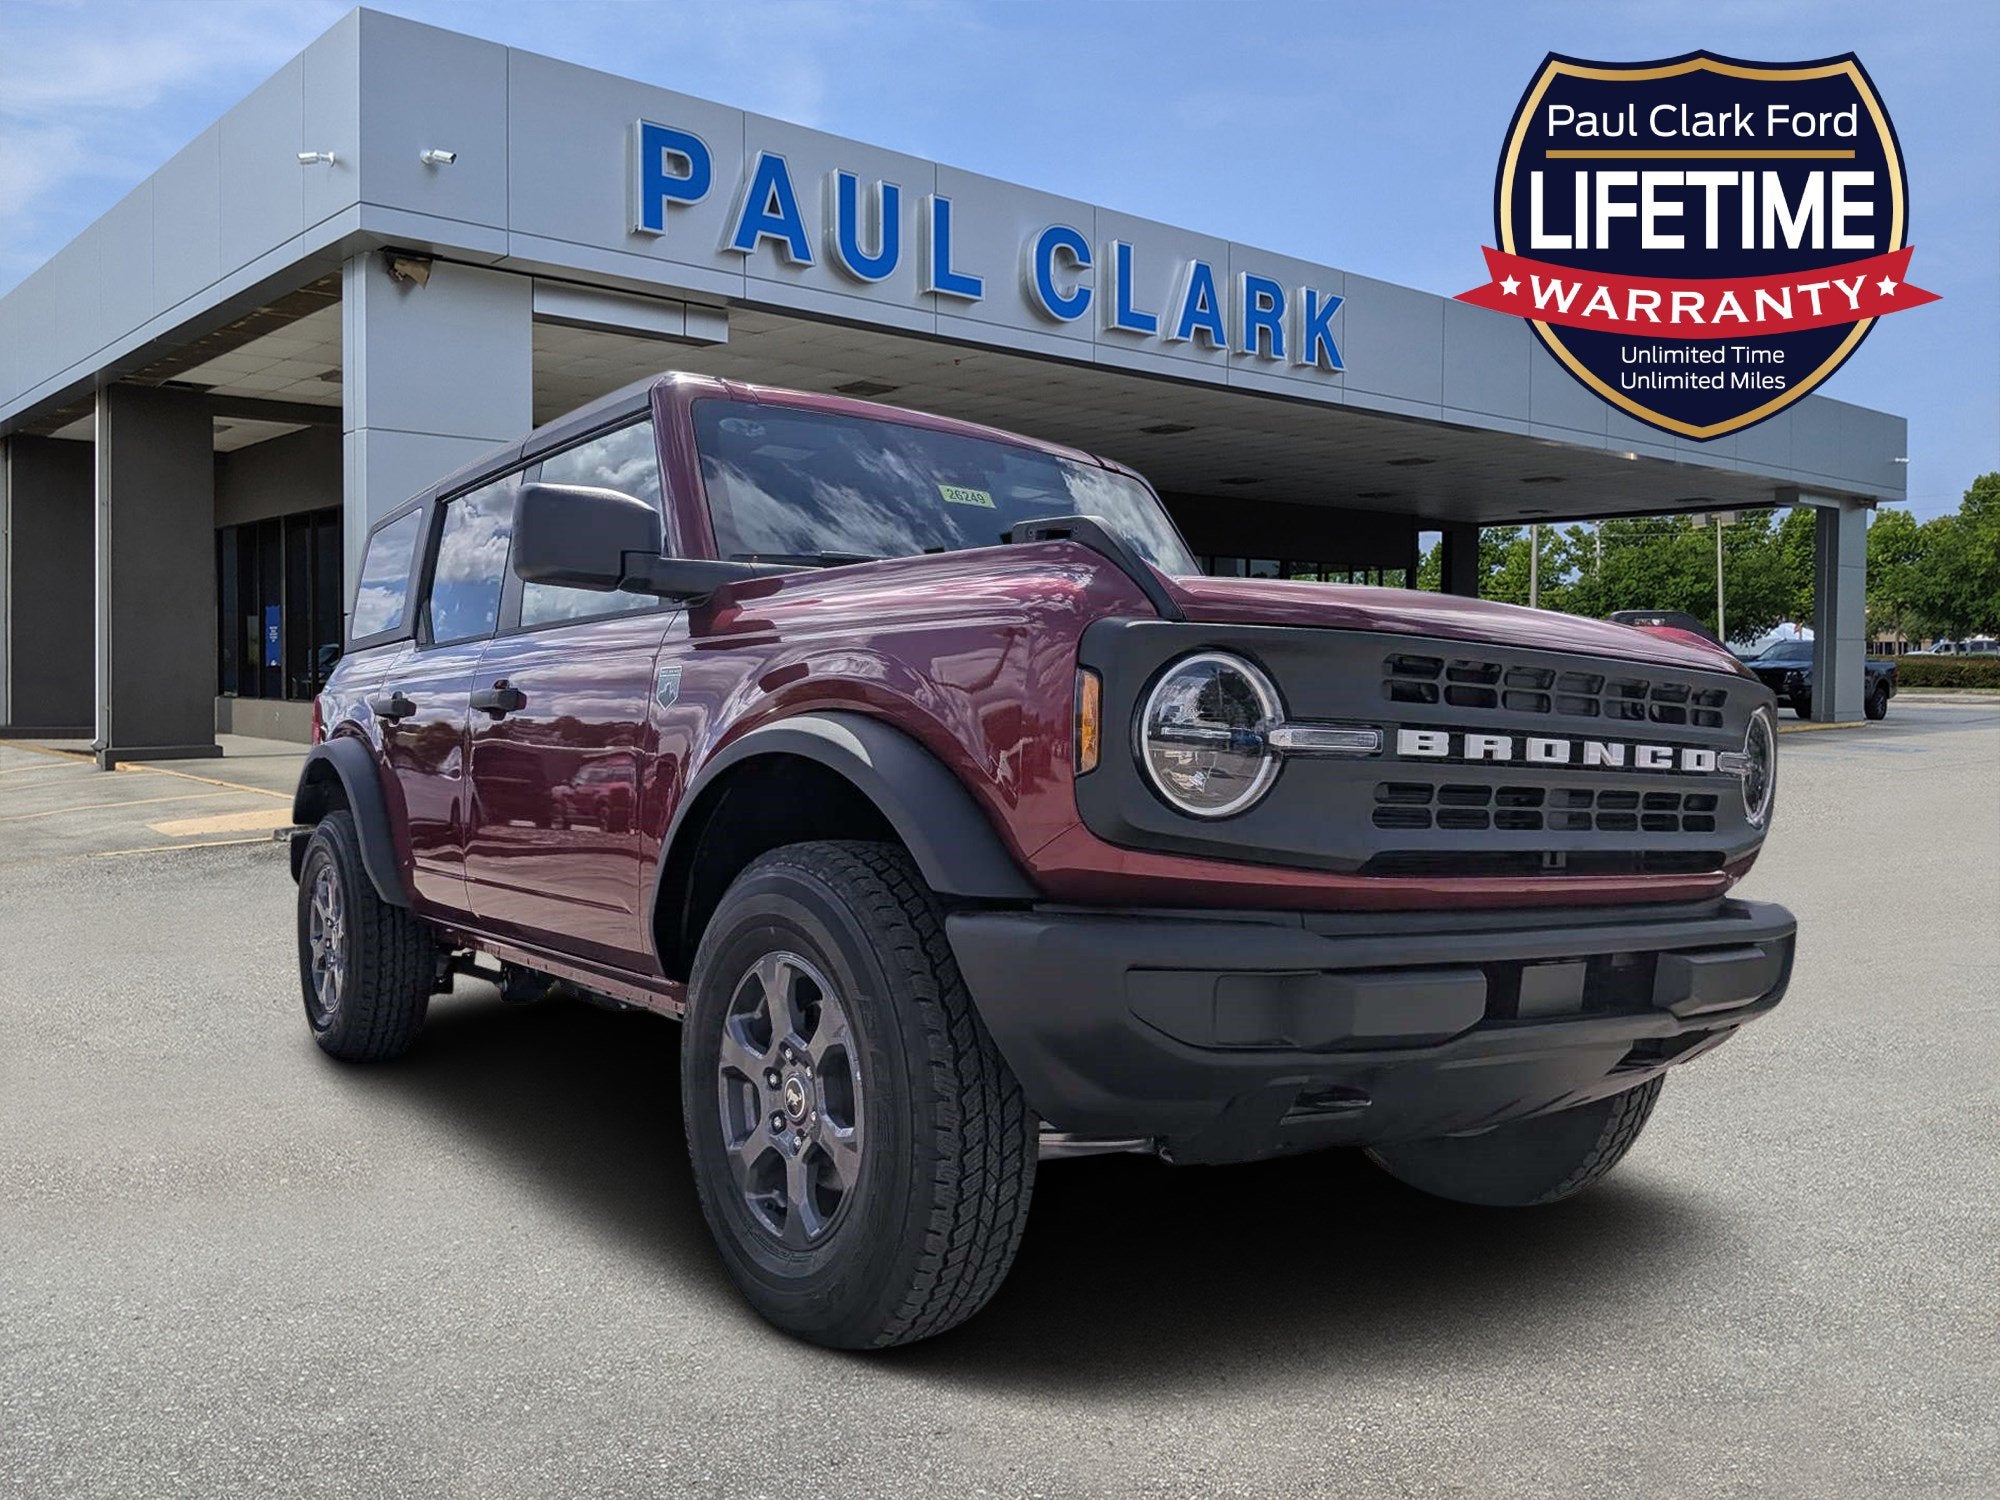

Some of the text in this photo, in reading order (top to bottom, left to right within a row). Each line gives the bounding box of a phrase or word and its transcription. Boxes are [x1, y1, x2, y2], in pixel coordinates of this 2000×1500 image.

[632, 118, 1346, 373] PAUL CLARK
[946, 488, 986, 504] 26249
[1397, 728, 1716, 772] BRONCO
